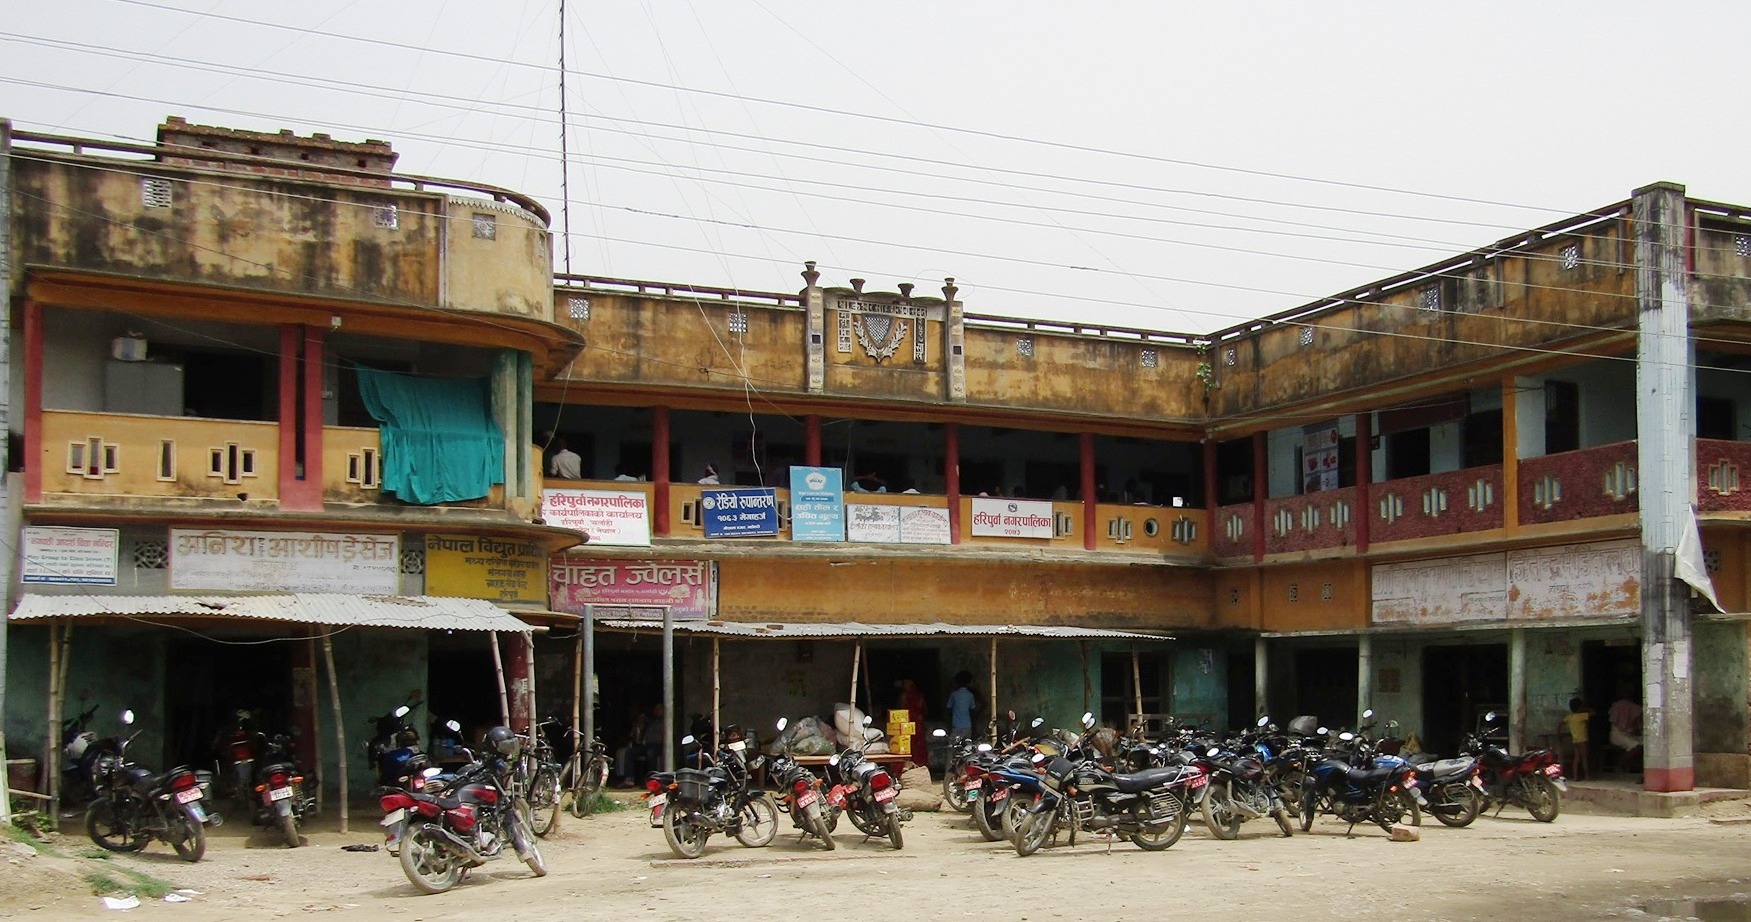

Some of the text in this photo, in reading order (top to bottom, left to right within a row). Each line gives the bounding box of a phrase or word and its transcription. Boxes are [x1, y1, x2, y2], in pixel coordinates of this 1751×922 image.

[587, 494, 645, 509] नगरपालिका
[716, 492, 738, 510] रेडियो
[1004, 513, 1052, 528] नगरपालिका
[427, 535, 473, 553] नेपाल
[478, 536, 516, 558] विद्युत
[552, 564, 617, 587] चाहत
[625, 562, 704, 587] ज्वेलर्स
